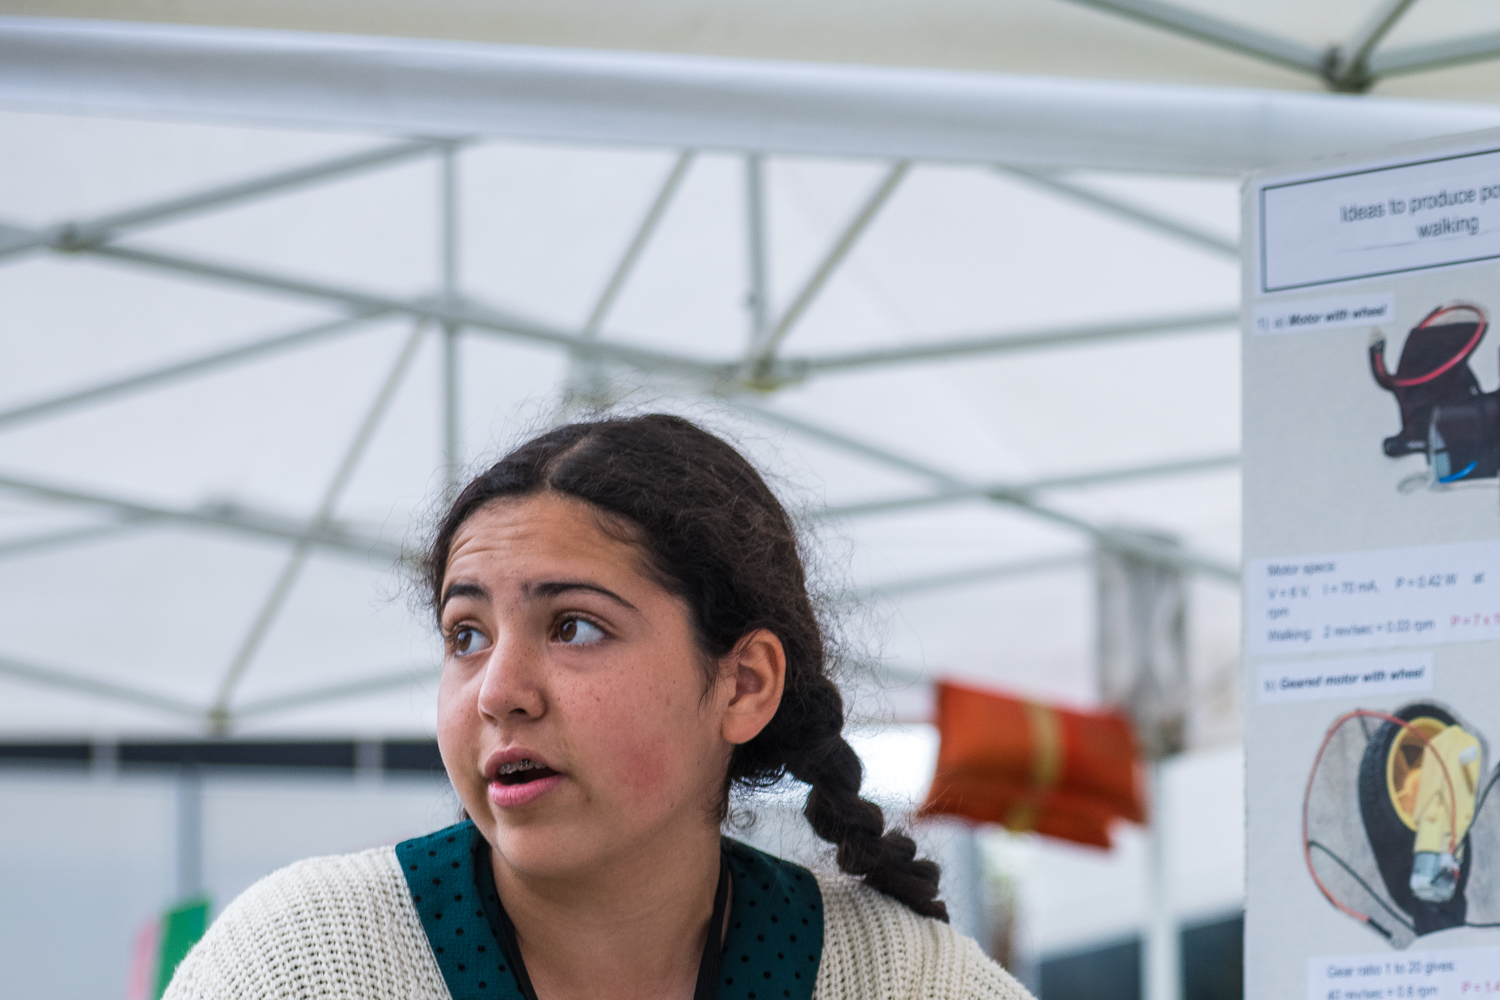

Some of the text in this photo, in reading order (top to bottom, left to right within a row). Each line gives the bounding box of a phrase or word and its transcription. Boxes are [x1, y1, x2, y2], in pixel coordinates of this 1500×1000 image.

[1339, 200, 1386, 223] Ideas
[1389, 198, 1406, 217] to
[1409, 186, 1476, 217] produce
[1416, 214, 1480, 239] walking
